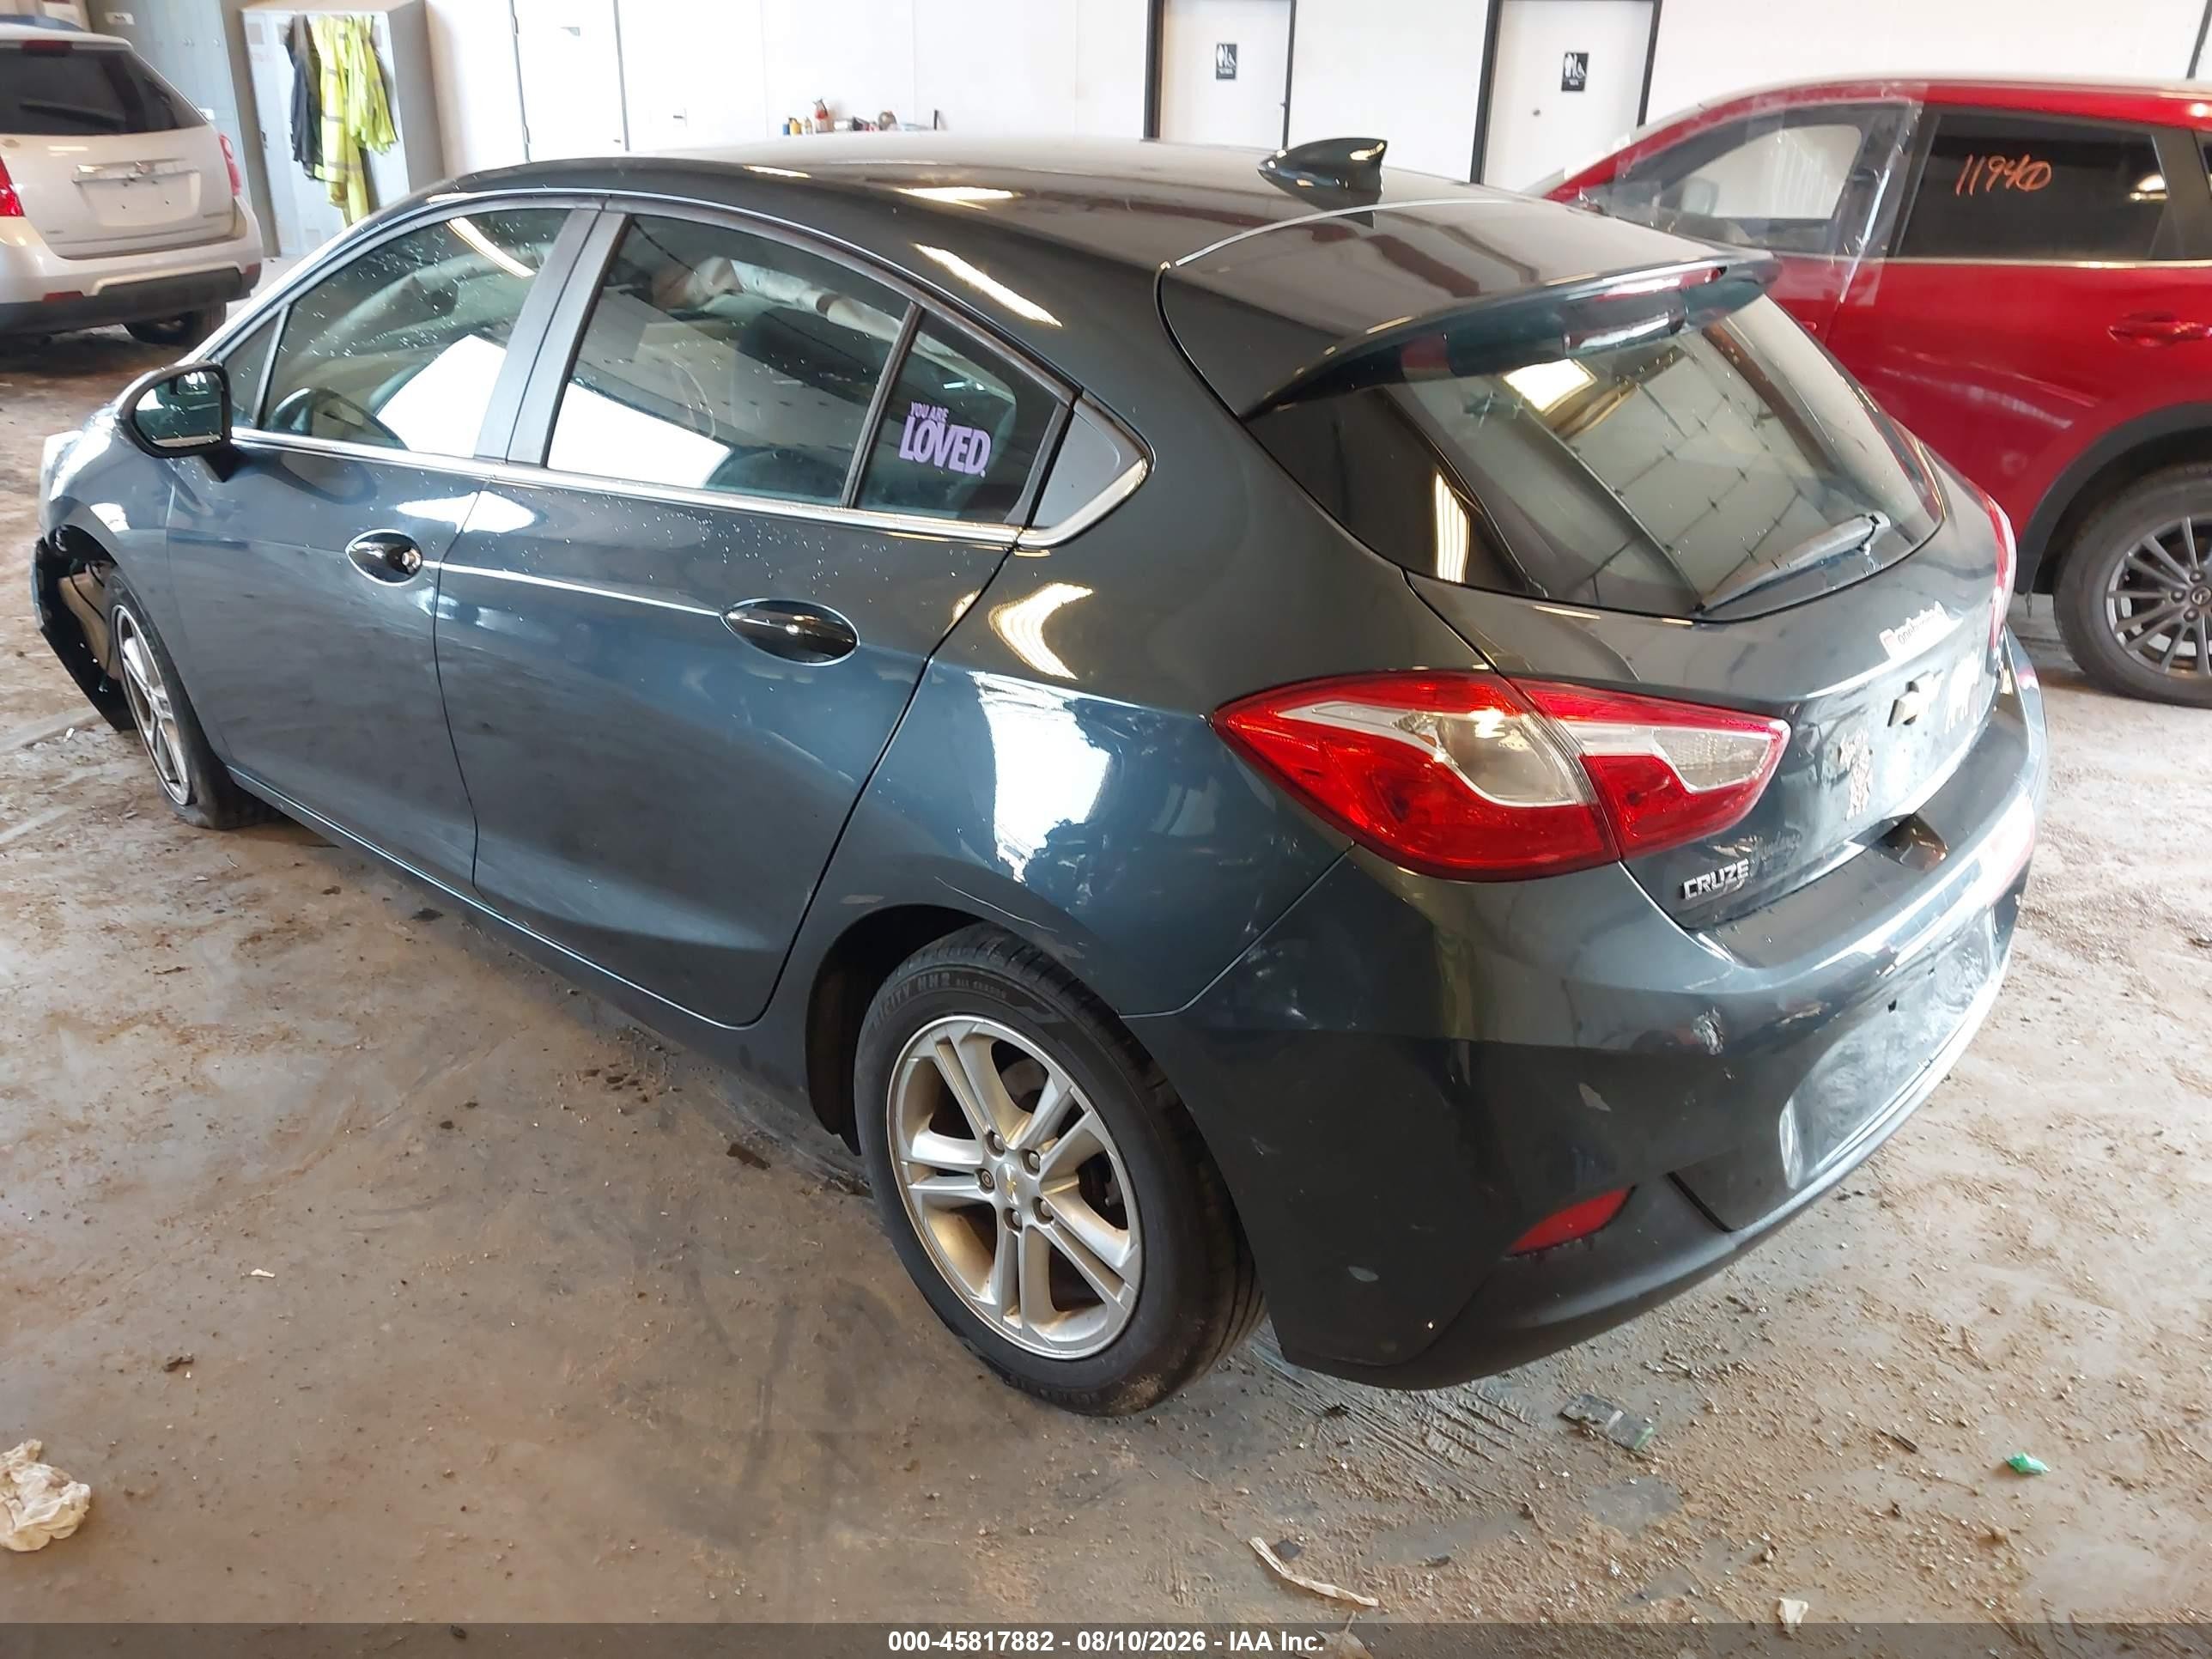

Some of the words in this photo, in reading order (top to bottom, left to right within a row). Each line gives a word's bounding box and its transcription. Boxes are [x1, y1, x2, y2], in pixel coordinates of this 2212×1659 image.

[1956, 154, 2051, 196] 11940
[910, 400, 930, 419] YOU
[930, 406, 949, 423] ARE
[1683, 858, 1749, 900] CRUZE
